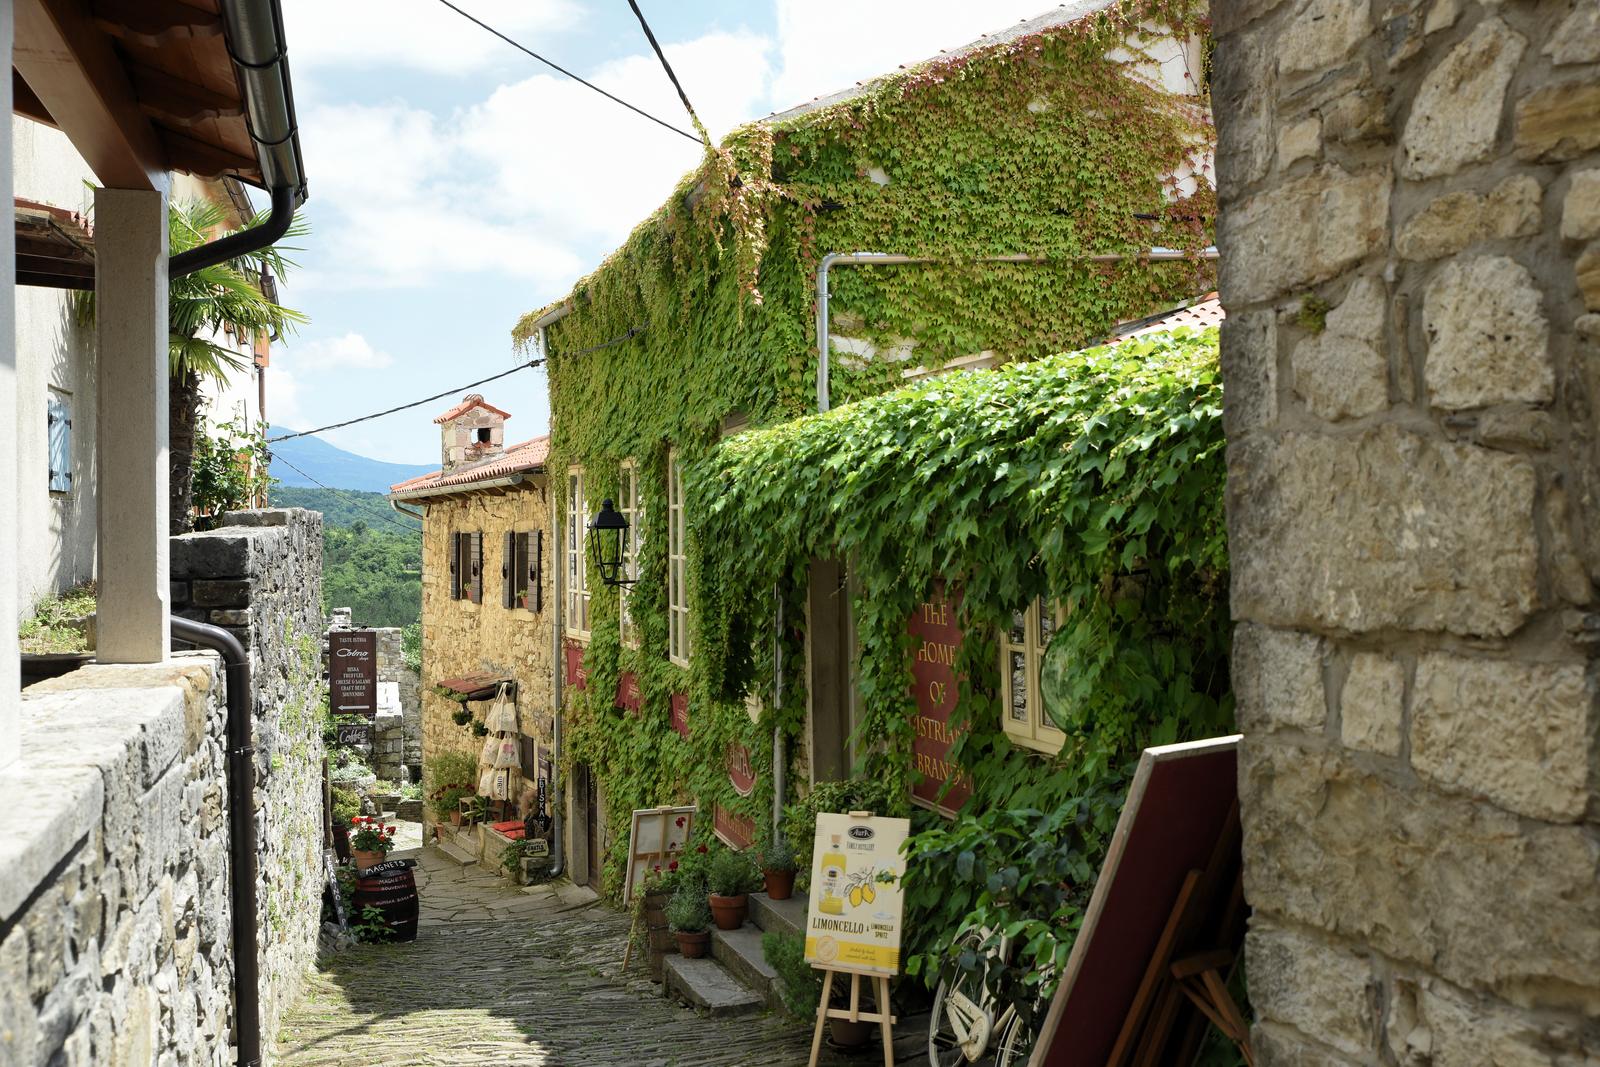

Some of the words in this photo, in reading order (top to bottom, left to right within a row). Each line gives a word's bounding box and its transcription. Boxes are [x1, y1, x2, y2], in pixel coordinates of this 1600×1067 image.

[922, 603, 948, 626] THE
[918, 641, 956, 666] HOME
[365, 860, 406, 875] MAGNETS
[812, 917, 864, 934] LIMONCELLO
[870, 923, 894, 931] LIMONCELLO
[874, 931, 888, 939] SPRITZ
